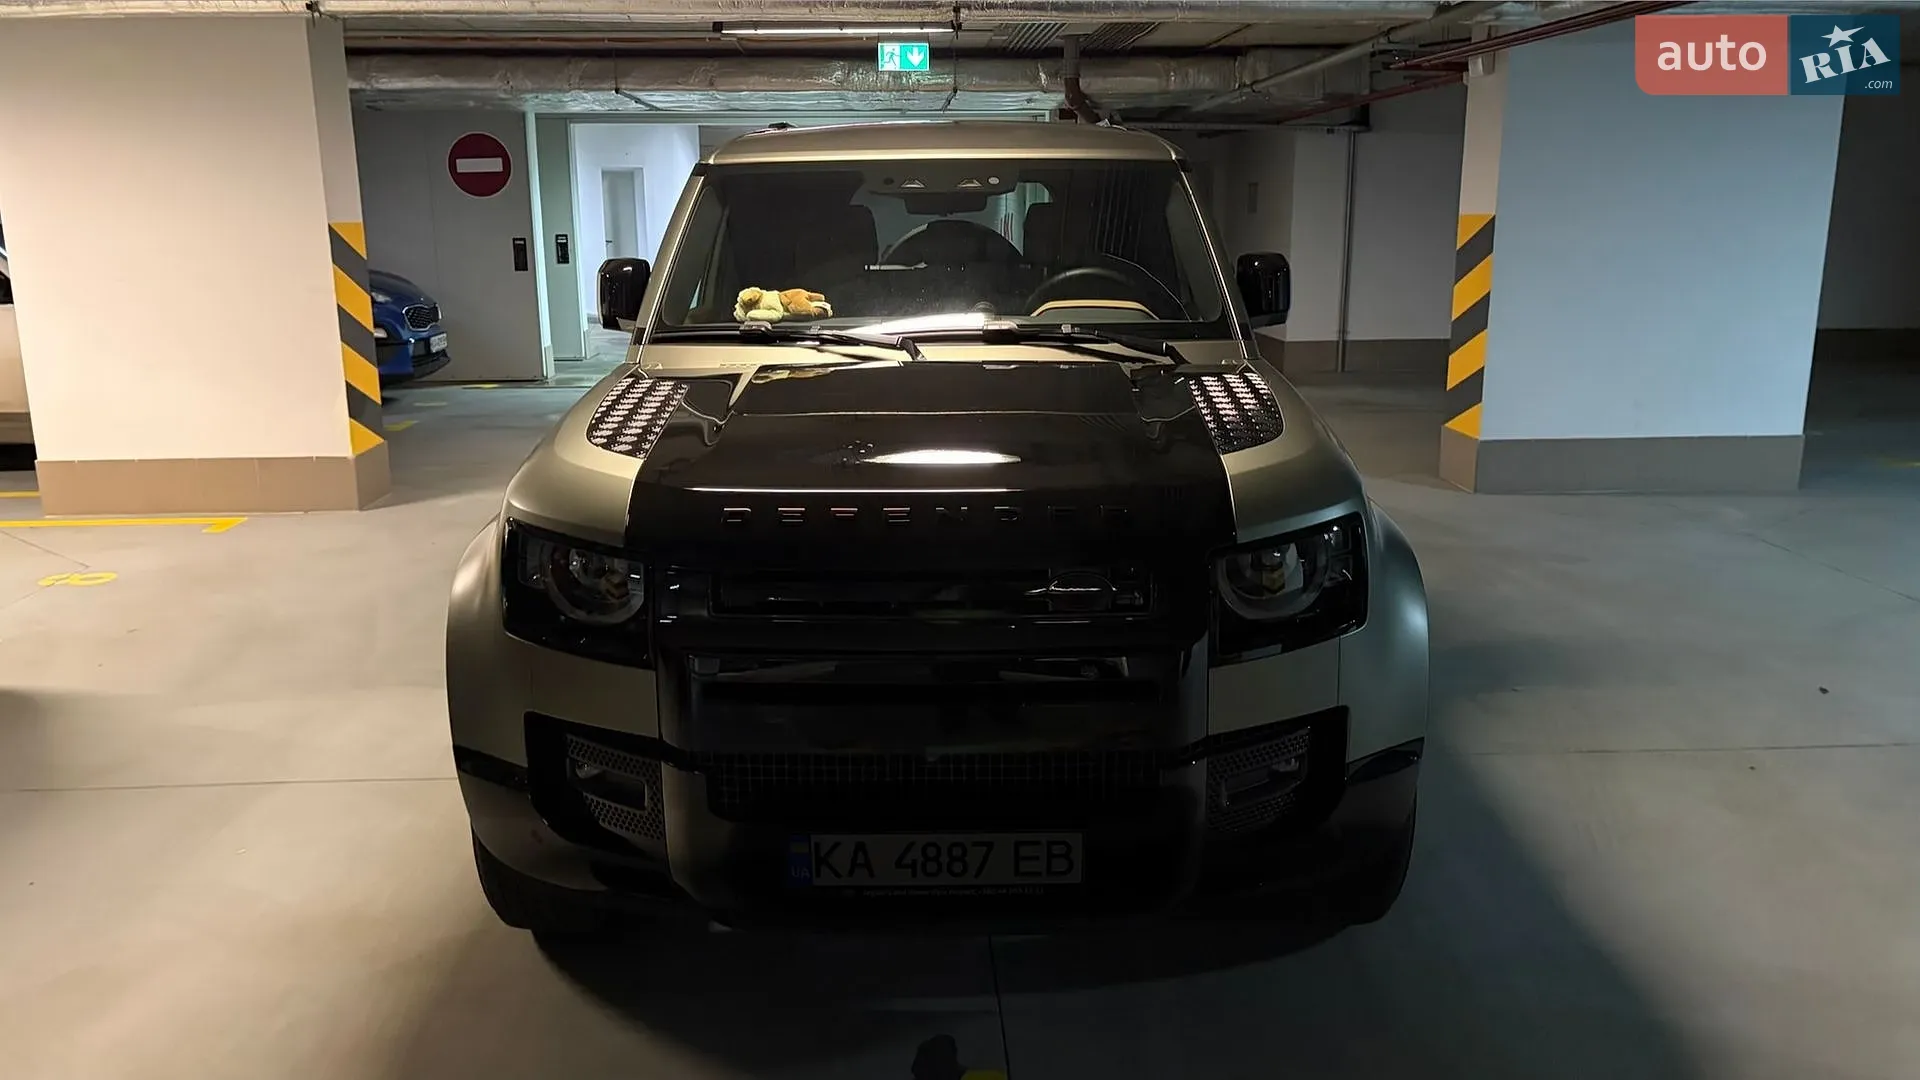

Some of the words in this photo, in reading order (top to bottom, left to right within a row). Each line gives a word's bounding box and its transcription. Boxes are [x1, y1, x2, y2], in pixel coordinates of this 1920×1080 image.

[721, 506, 1133, 523] DEFENDER
[814, 841, 875, 878] KA
[895, 841, 994, 878] 4887
[1014, 841, 1074, 877] EB
[791, 866, 811, 880] UA
